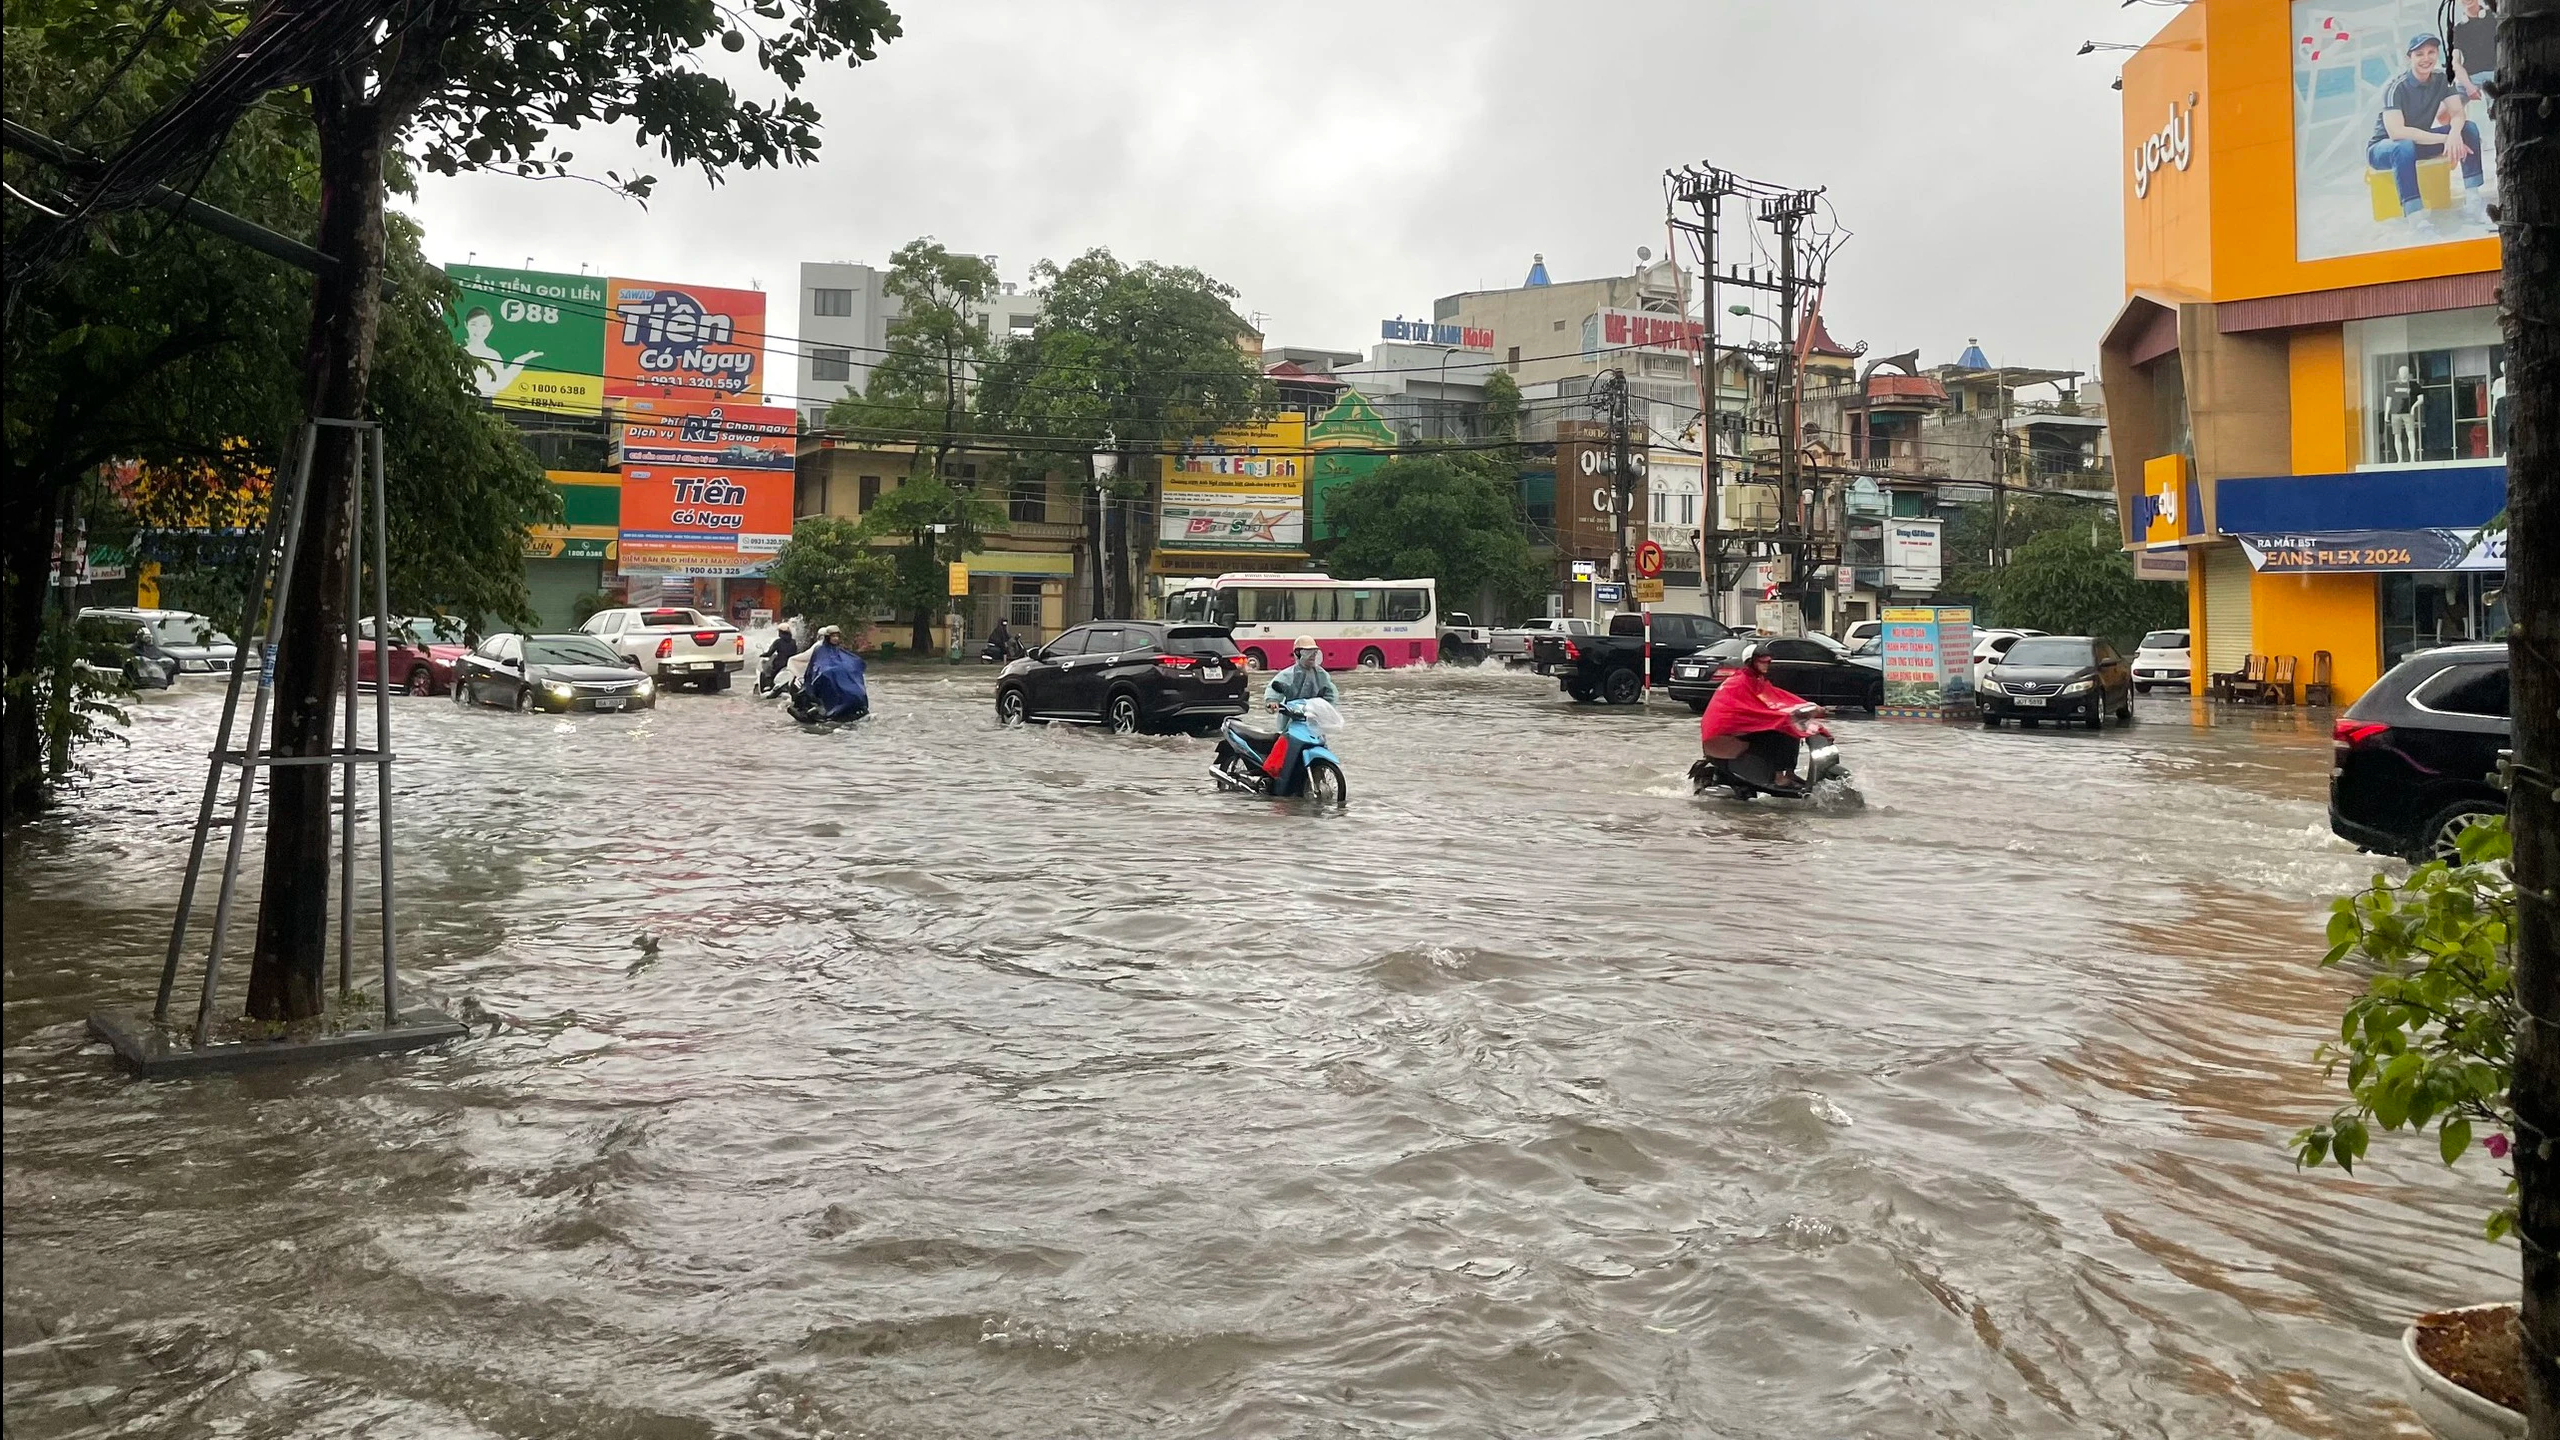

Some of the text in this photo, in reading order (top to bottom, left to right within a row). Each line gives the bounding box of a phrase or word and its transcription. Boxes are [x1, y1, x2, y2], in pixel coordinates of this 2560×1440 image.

[2134, 101, 2190, 199] yody
[618, 288, 655, 300] SAWAD
[500, 298, 560, 325] F88
[617, 296, 732, 343] Tiền
[639, 346, 751, 373] Có Ngay
[531, 383, 586, 395] 1800 6388
[1174, 454, 1296, 478] Smart English
[673, 477, 747, 505] Tiền
[2145, 482, 2176, 527] yody
[671, 508, 743, 529] Có Ngay
[2257, 538, 2272, 548] RA
[2264, 548, 2411, 566] EANS FLEX 2024
[707, 567, 723, 575] 633
